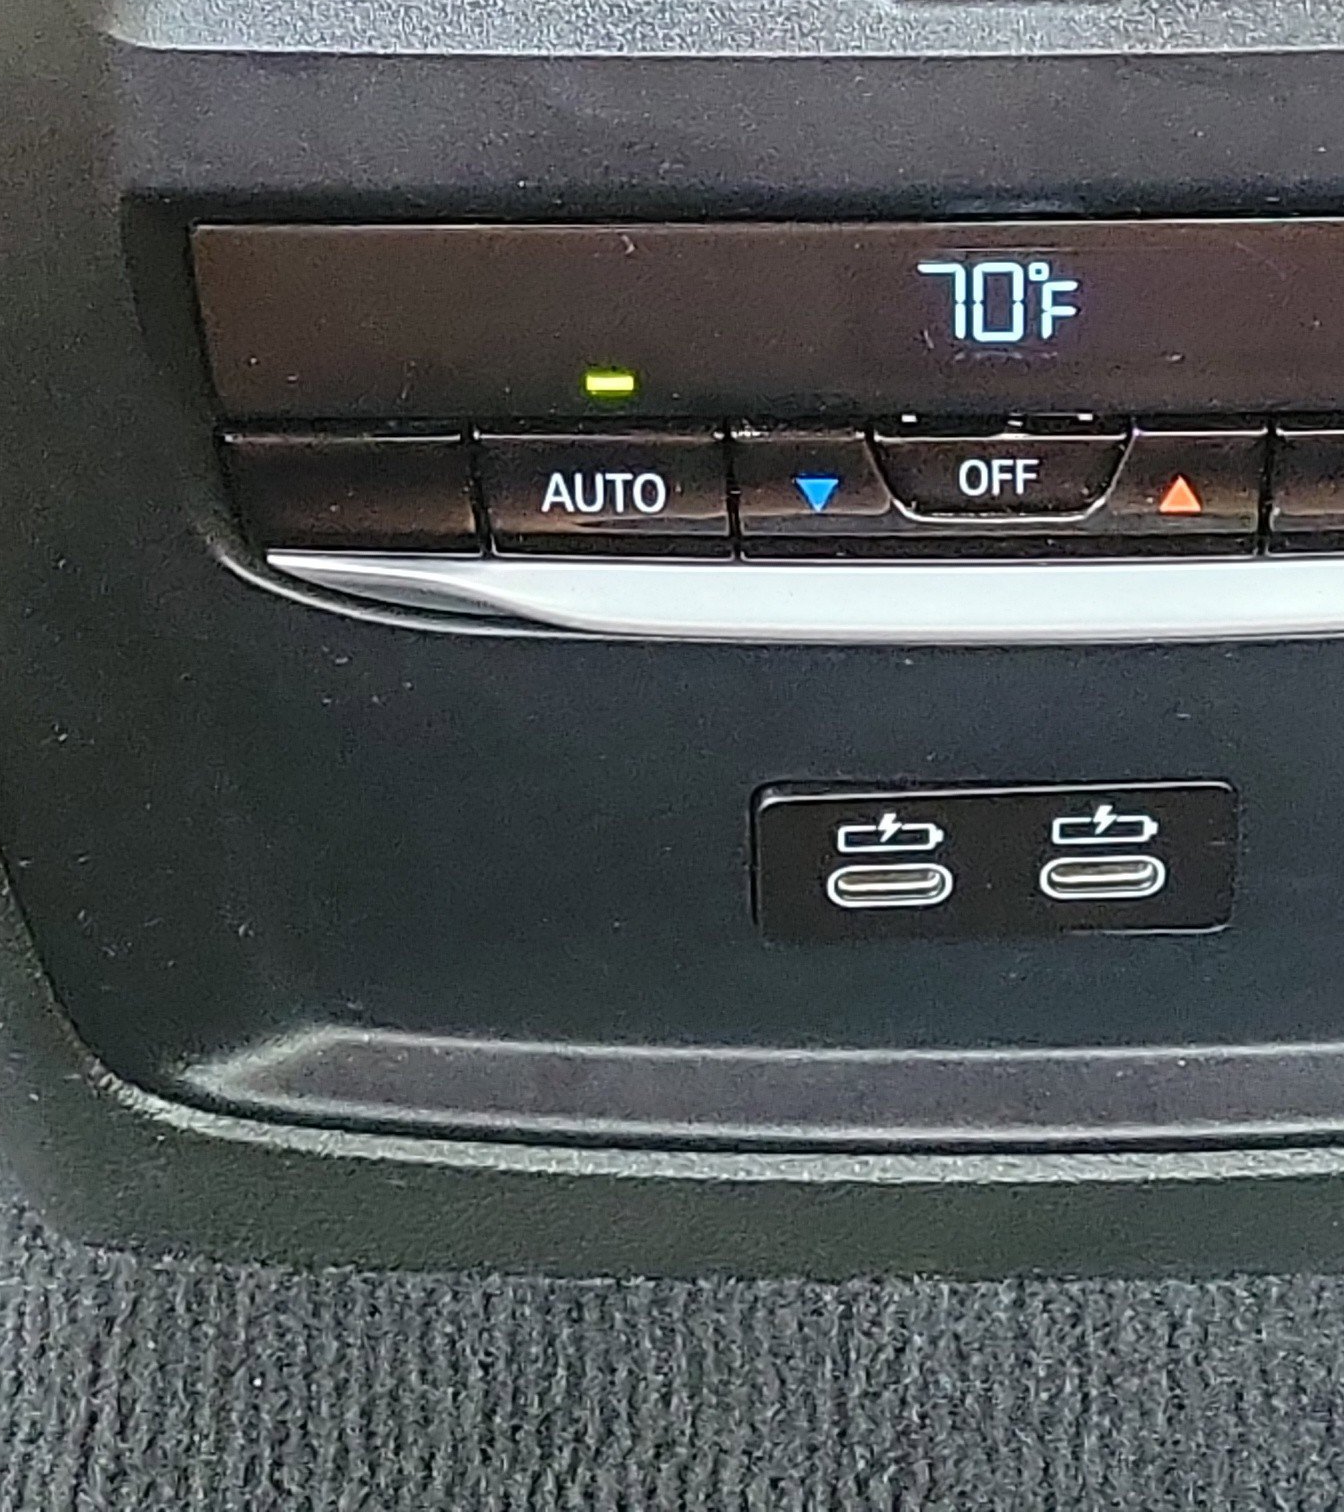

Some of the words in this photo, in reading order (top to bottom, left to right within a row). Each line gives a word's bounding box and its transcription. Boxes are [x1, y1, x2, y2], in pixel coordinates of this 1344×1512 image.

[917, 261, 1079, 343] 70°F
[541, 472, 667, 514] AUTO
[958, 458, 1040, 497] OFF
